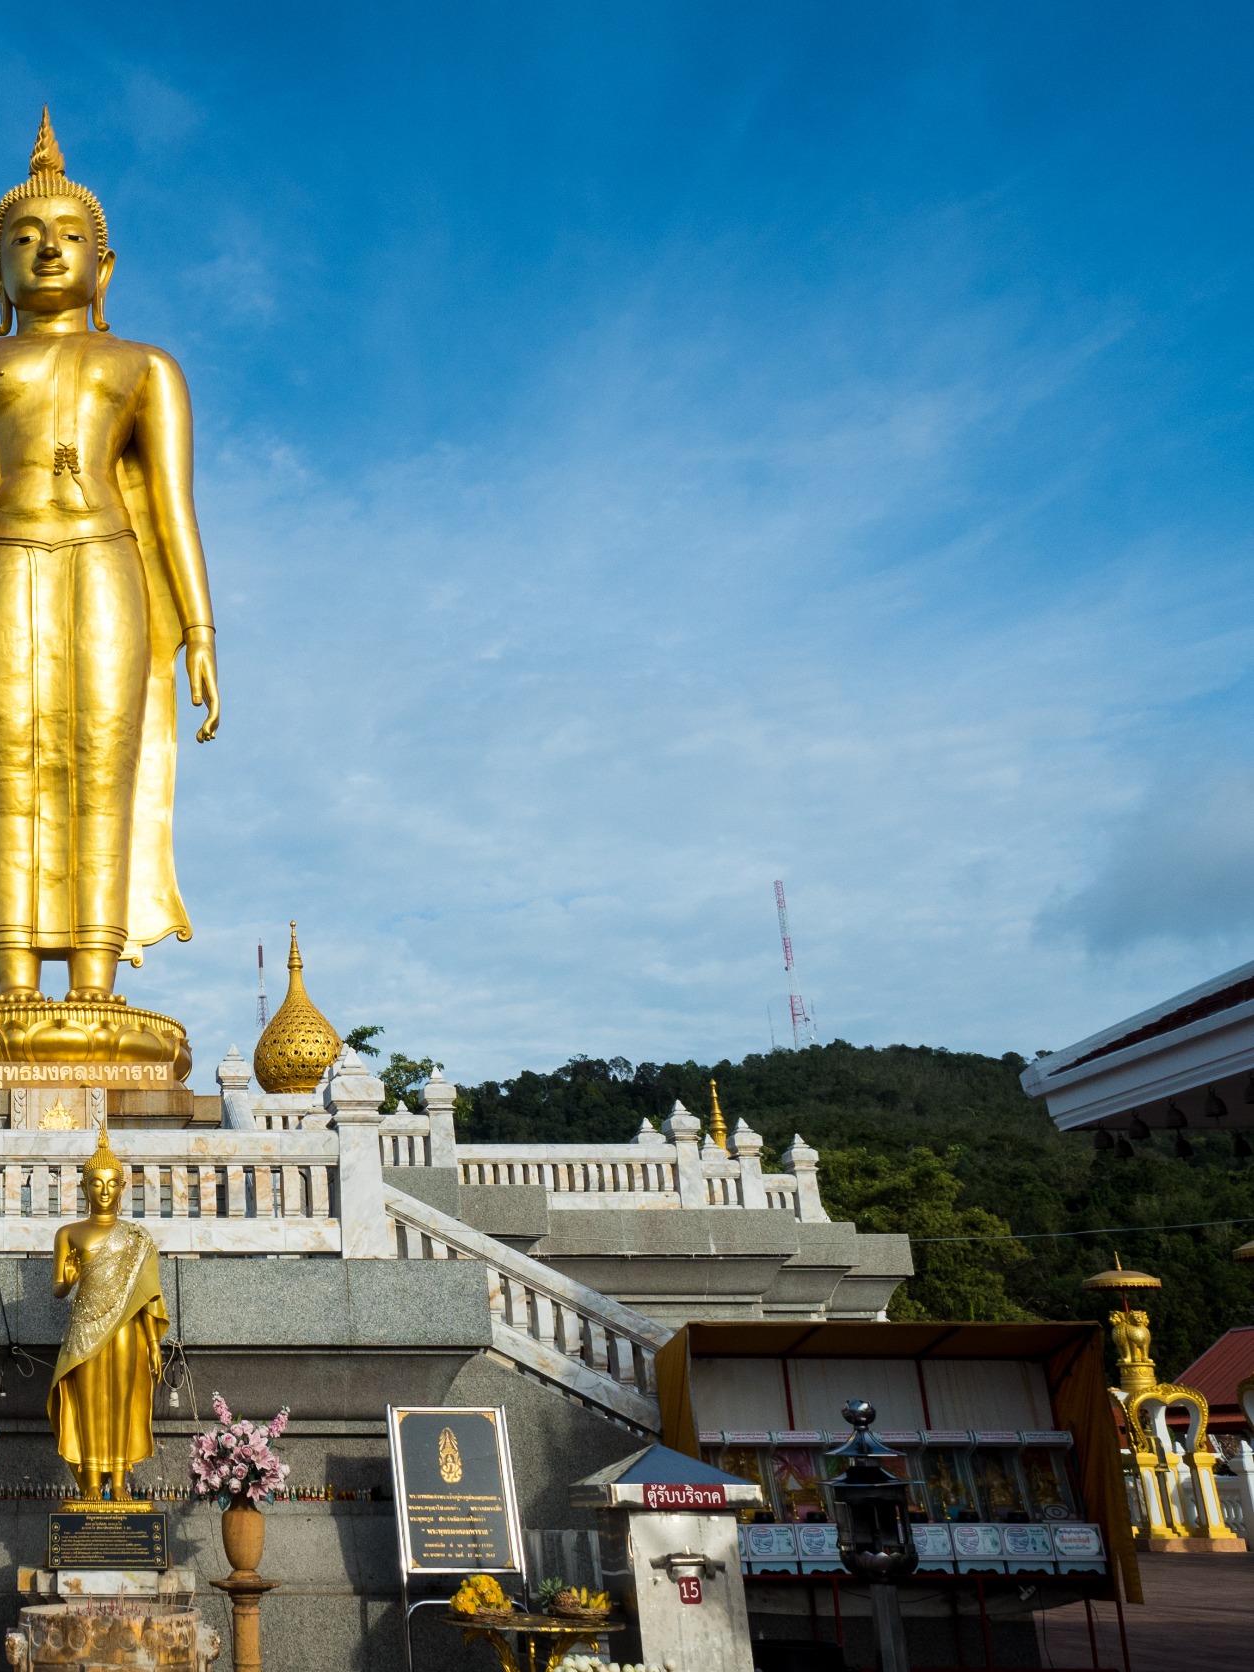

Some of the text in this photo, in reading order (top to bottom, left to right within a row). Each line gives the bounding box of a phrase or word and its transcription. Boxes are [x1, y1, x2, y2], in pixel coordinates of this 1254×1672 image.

[647, 1484, 722, 1508] ตู้รับบริจาค
[680, 1581, 700, 1599] 15
